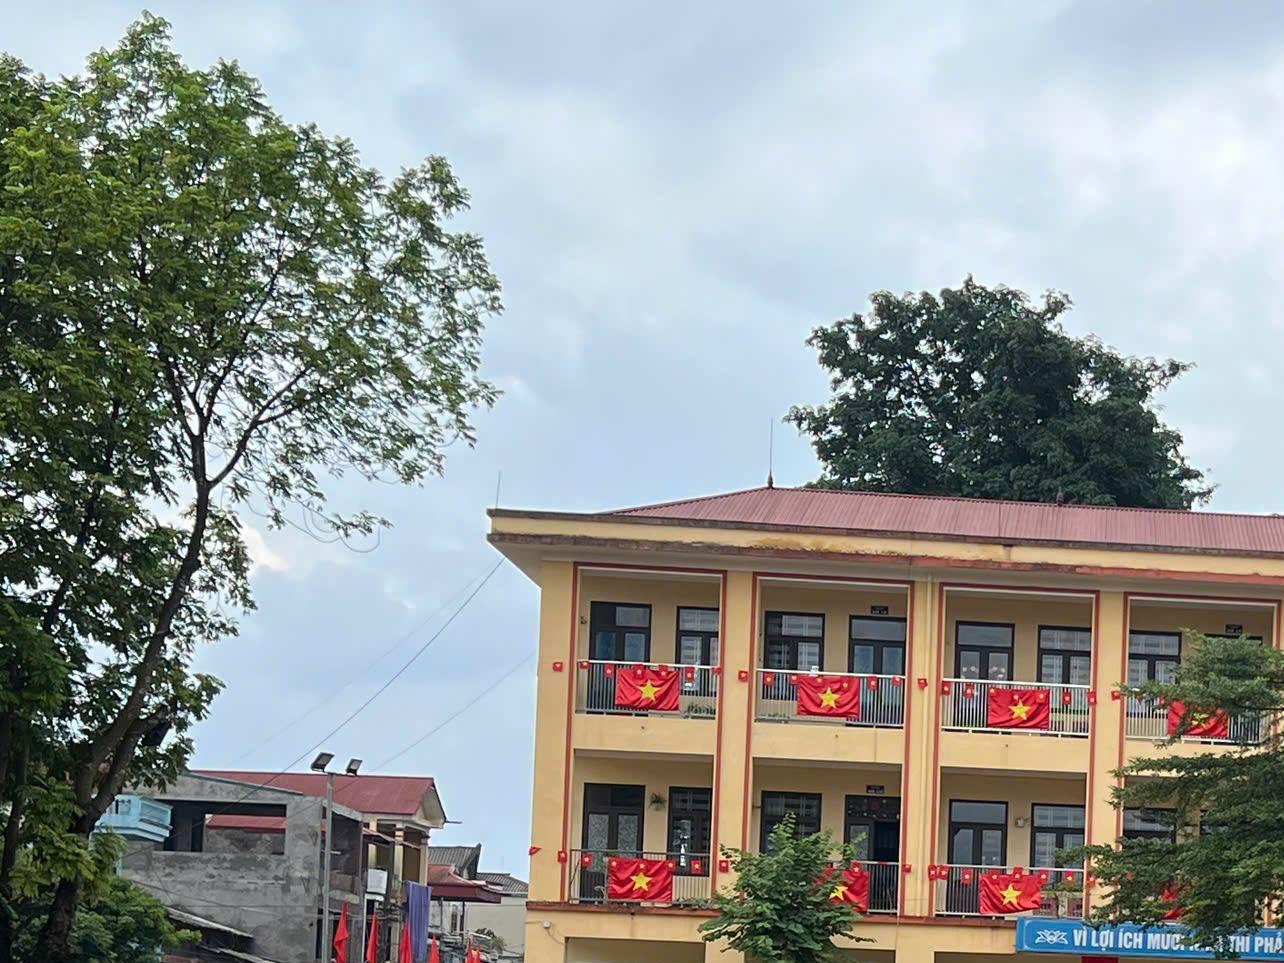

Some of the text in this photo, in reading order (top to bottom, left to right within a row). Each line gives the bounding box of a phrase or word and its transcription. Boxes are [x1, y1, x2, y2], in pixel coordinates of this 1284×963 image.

[1073, 926, 1088, 946] VÌ
[1091, 929, 1114, 951] LỢI
[1118, 928, 1144, 949] ÍCH
